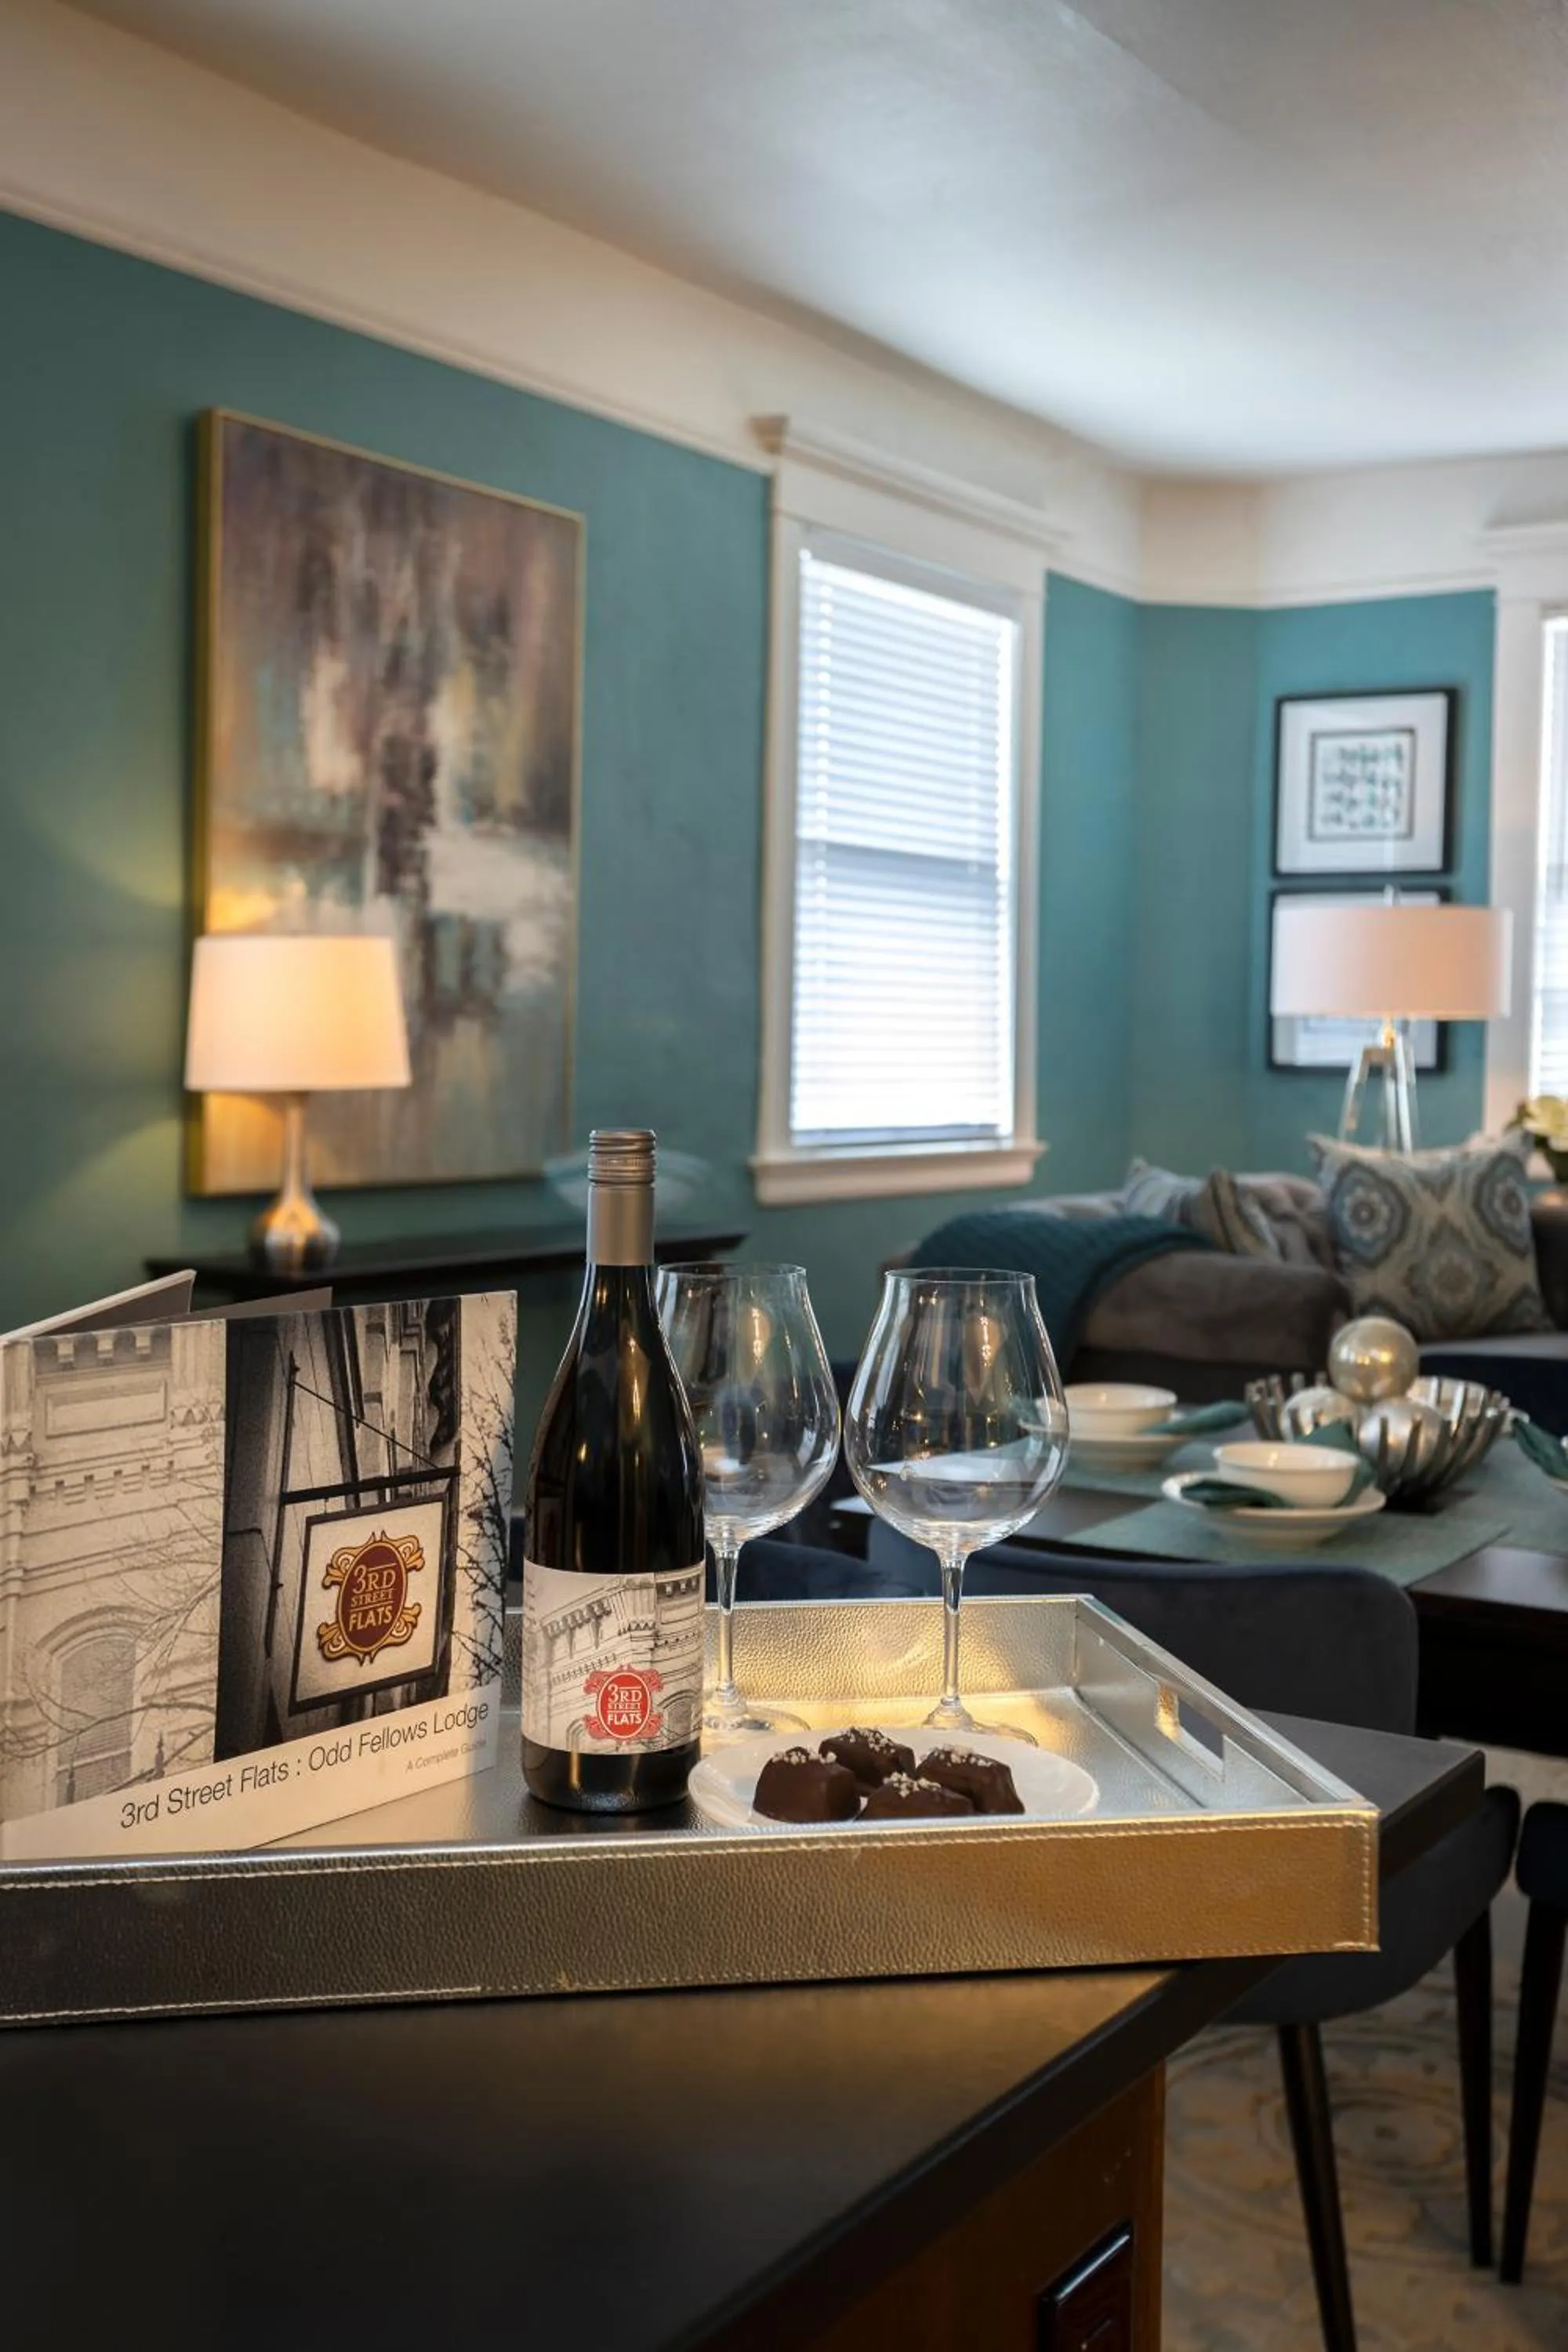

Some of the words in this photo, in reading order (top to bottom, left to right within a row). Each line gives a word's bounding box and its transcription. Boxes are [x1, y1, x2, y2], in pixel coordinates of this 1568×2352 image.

[353, 1565, 395, 1594] 3RD
[351, 1589, 394, 1606] STREET
[349, 1606, 393, 1631] FLATS
[608, 1683, 642, 1703] 3RD
[608, 1713, 642, 1725] FLATS
[121, 1794, 159, 1828] 3rd
[167, 1774, 232, 1814] Street
[240, 1761, 289, 1792] Flats
[308, 1738, 352, 1770] Odd
[358, 1720, 427, 1757] Fellows
[434, 1703, 488, 1734] Lodge
[405, 1761, 413, 1773] A
